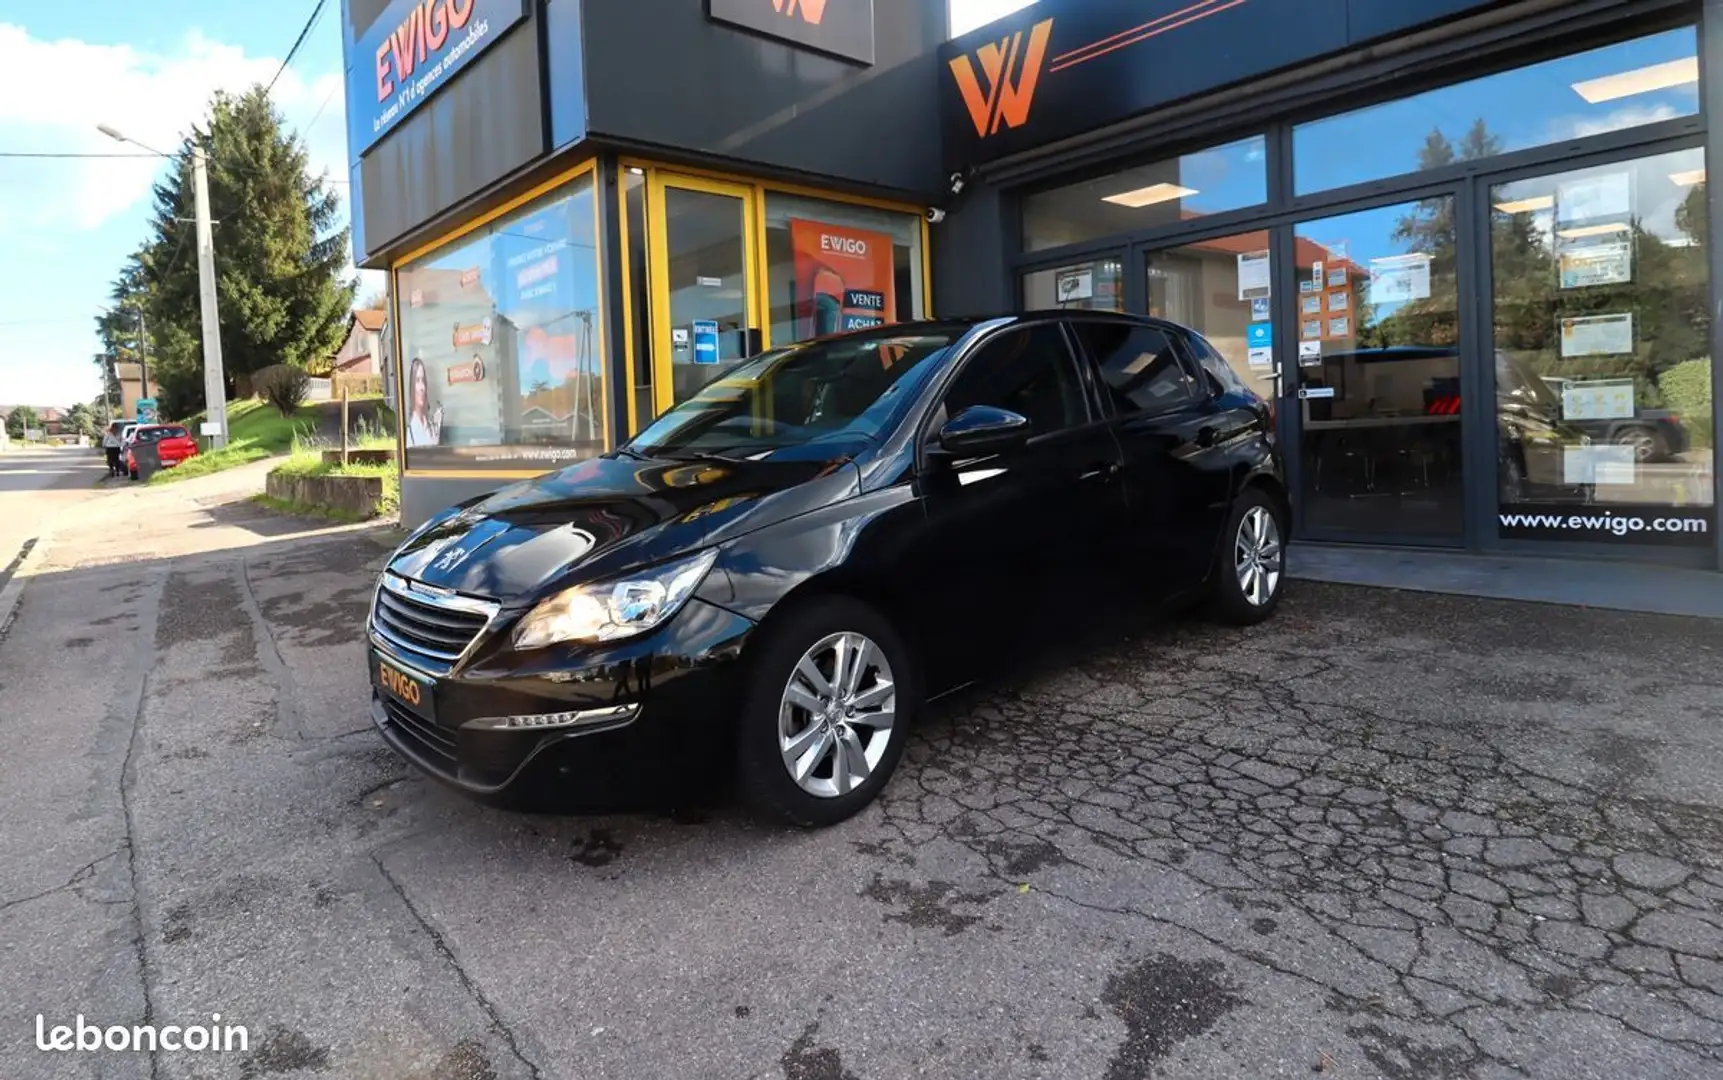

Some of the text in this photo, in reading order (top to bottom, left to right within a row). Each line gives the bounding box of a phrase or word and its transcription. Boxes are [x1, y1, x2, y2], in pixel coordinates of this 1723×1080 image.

[820, 233, 866, 254] EWIGO
[850, 293, 882, 307] VENTE
[522, 446, 577, 463] www.ewigo.com
[1499, 511, 1708, 535] www.ewigo.com
[380, 661, 421, 706] EWIGO
